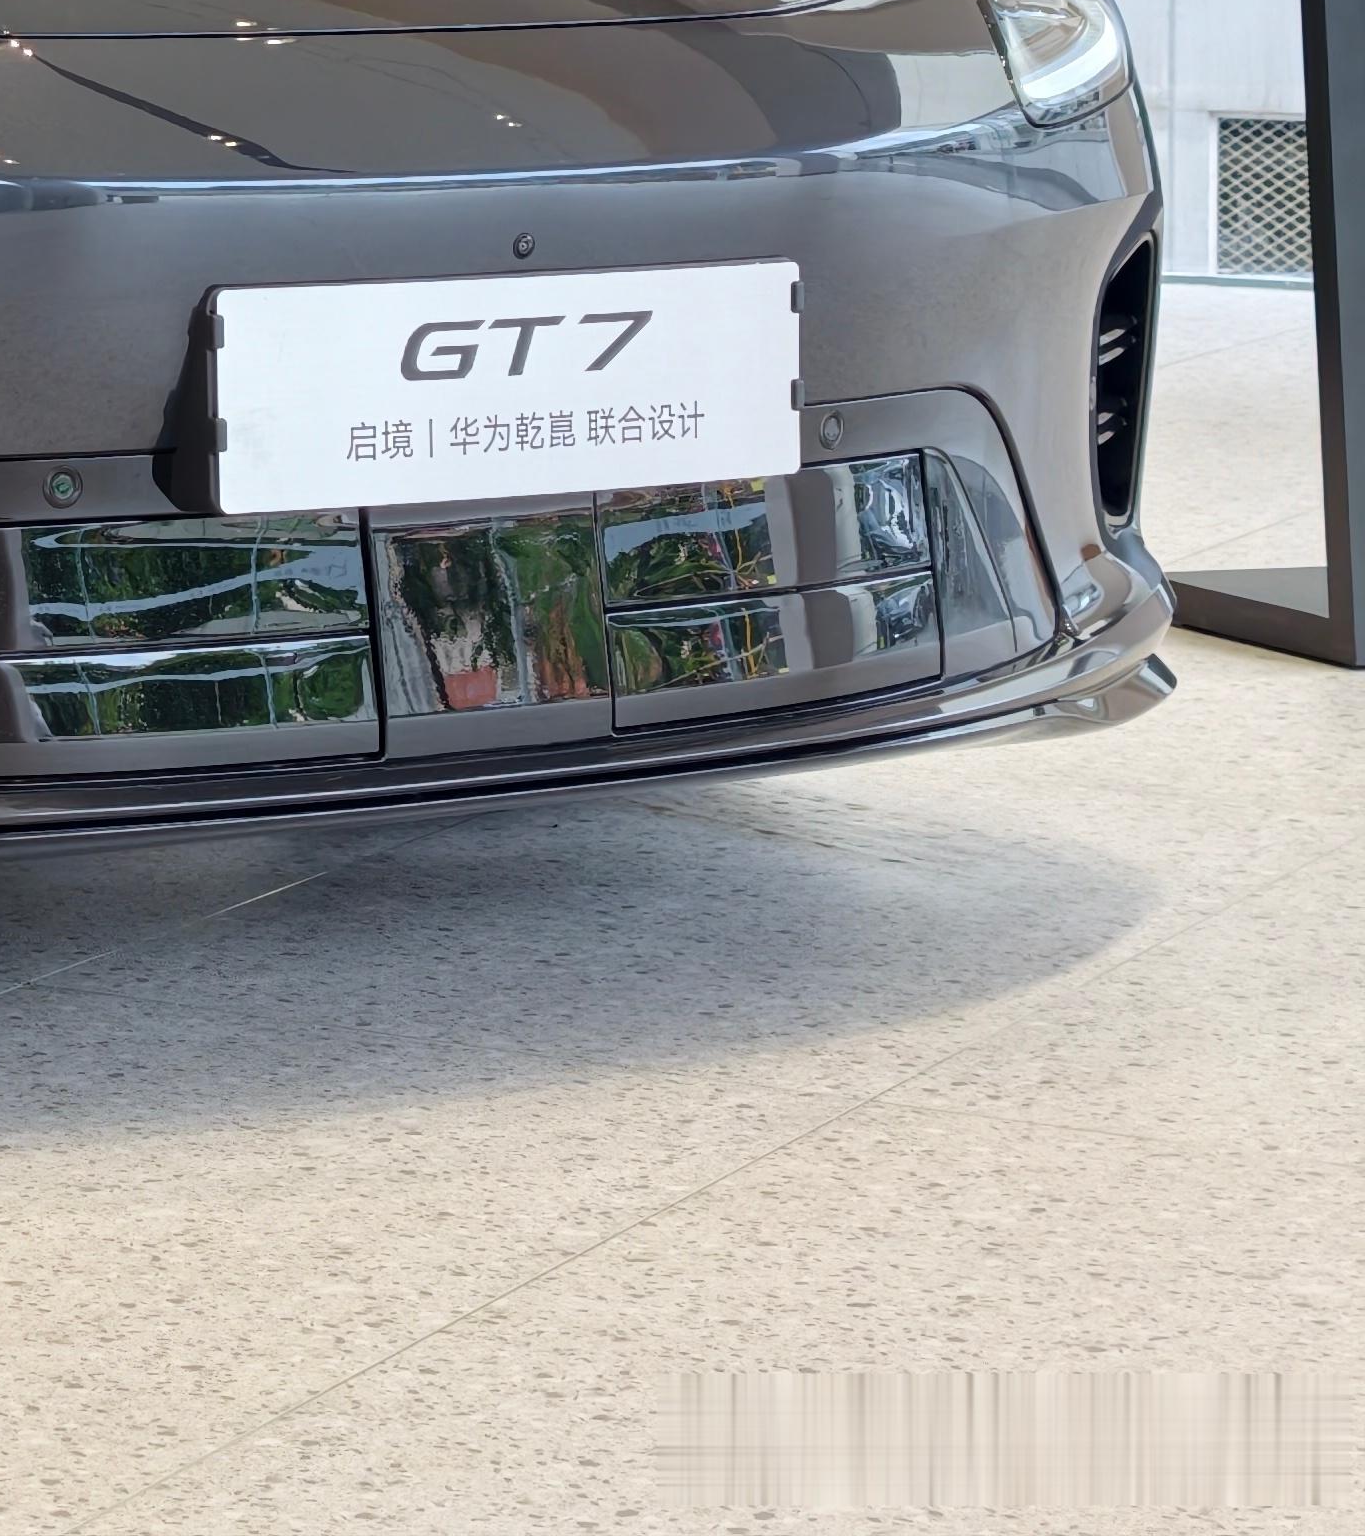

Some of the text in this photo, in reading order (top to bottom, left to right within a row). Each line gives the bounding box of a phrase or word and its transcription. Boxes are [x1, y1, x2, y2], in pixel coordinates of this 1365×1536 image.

[346, 419, 414, 462] 启境
[449, 409, 577, 456] 华为乾崑
[586, 400, 706, 445] 联合设计
